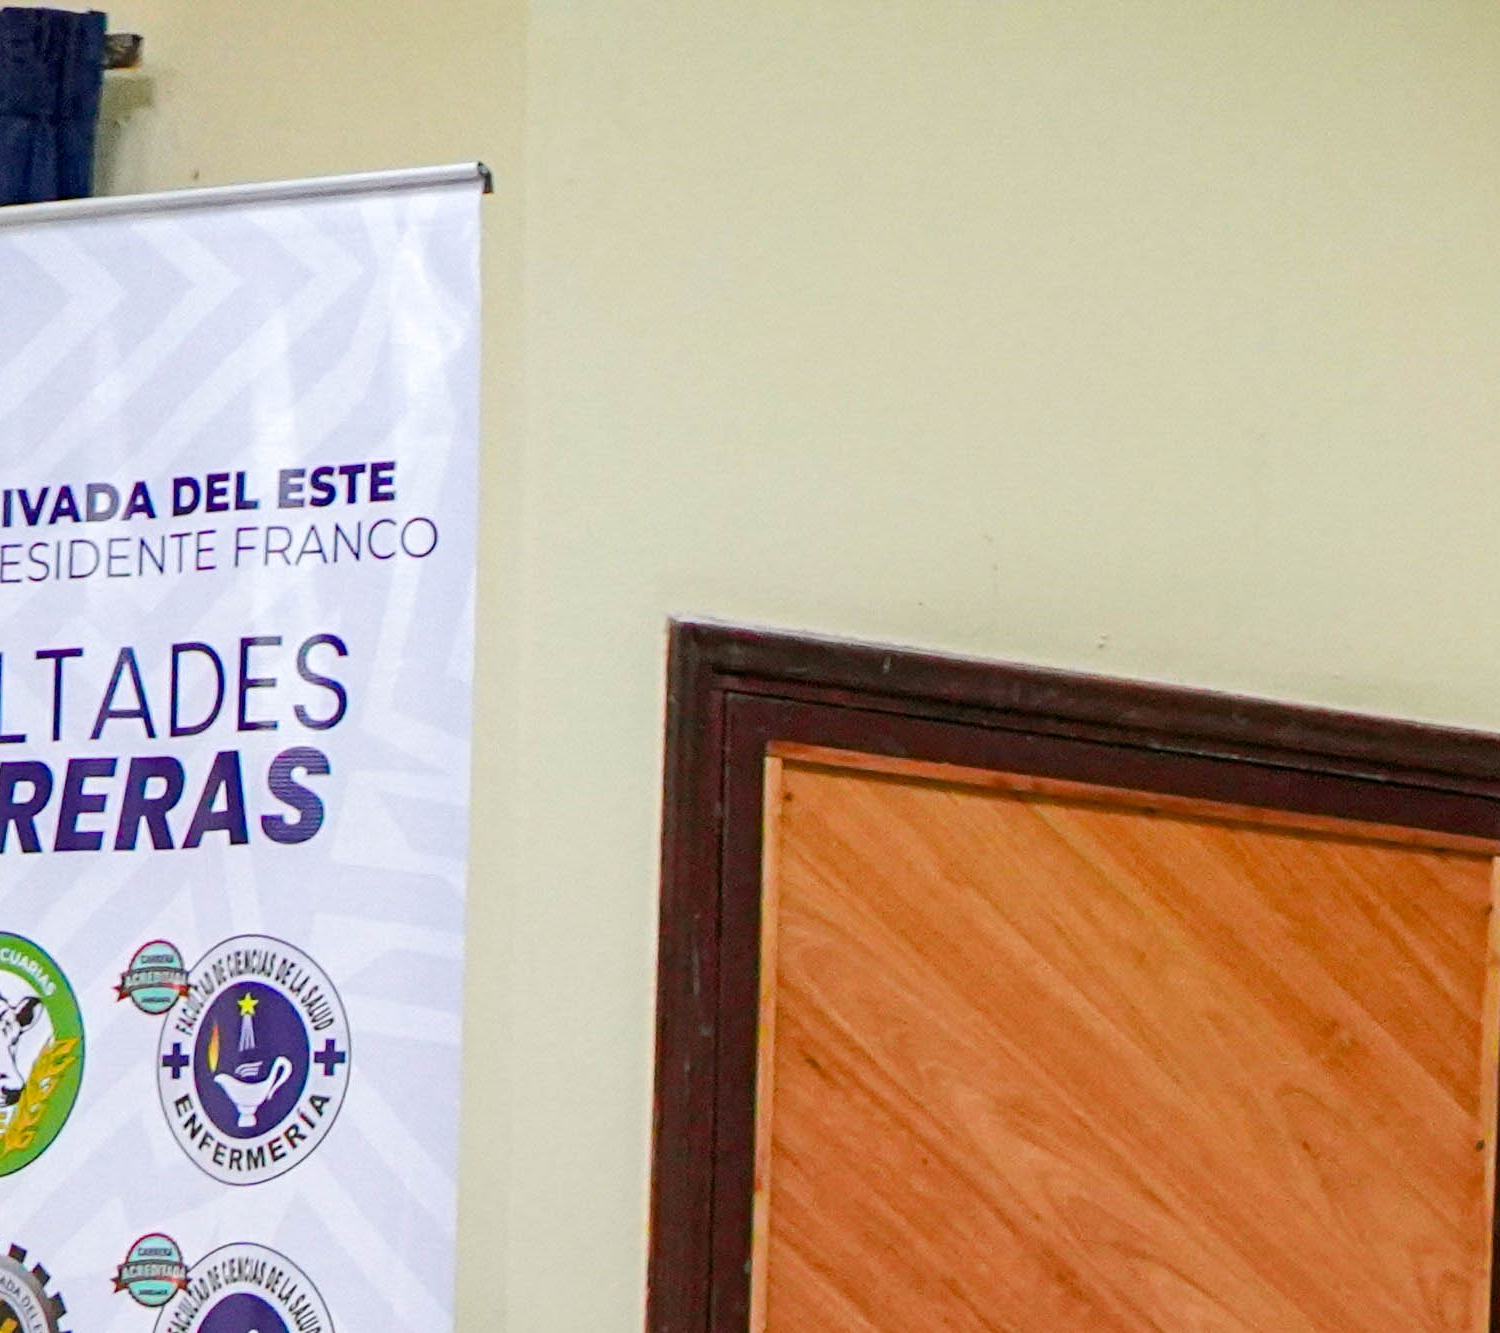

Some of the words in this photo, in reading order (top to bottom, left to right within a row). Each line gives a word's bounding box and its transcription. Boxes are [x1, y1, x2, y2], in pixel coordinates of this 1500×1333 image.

[170, 472, 259, 514] DEL
[277, 461, 397, 509] ESTE
[234, 517, 438, 570] FRANCO
